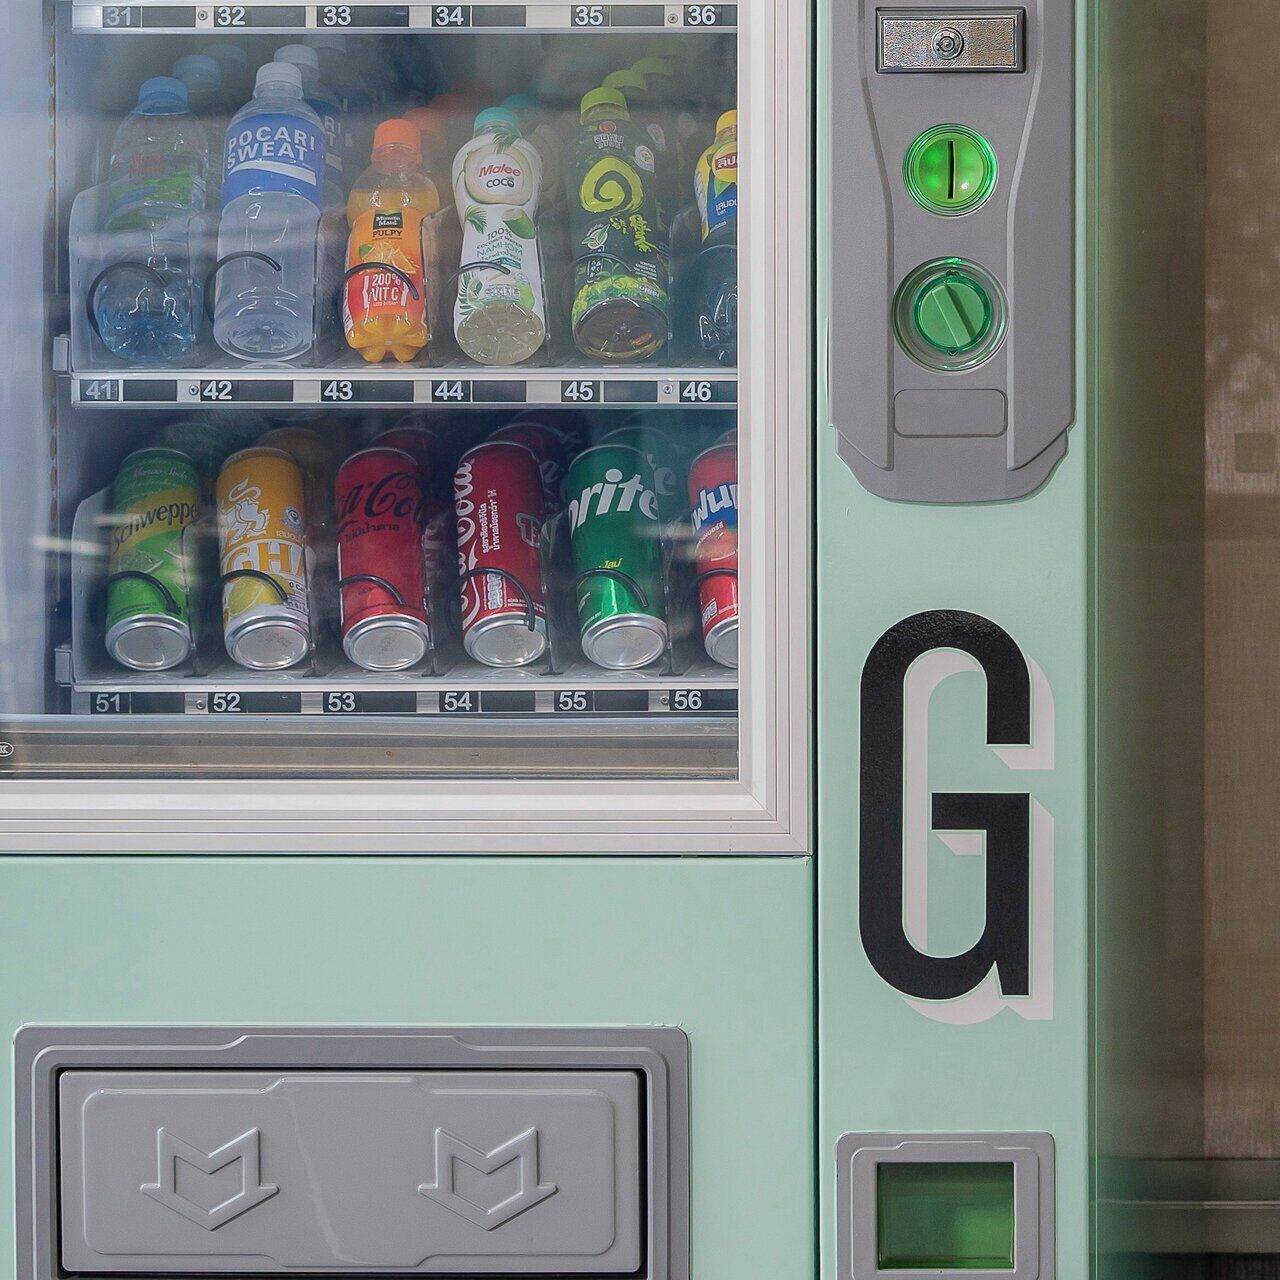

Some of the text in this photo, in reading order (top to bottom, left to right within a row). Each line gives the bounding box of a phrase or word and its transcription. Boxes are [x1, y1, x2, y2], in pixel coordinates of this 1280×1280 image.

[105, 7, 131, 26] 31
[217, 6, 245, 25] 32
[323, 6, 351, 25] 33
[435, 6, 463, 26] 34
[575, 6, 603, 26] 35
[687, 6, 715, 26] 36
[228, 126, 315, 155] POCARI
[227, 142, 308, 169] SWEAT
[479, 164, 521, 178] Malee
[372, 229, 403, 238] PULPY
[487, 227, 513, 240] 100%
[372, 273, 401, 286] 200%
[372, 287, 398, 301] VIT C
[86, 381, 111, 400] 41
[203, 381, 232, 400] 42
[324, 381, 353, 400] 43
[435, 381, 464, 400] 44
[564, 381, 593, 400] 45
[682, 381, 711, 400] 46
[95, 693, 121, 712] 51
[212, 693, 241, 712] 52
[327, 693, 356, 712] 53
[444, 692, 472, 711] 54
[559, 692, 587, 711] 55
[674, 692, 702, 710] 56
[859, 609, 1031, 1000] G
